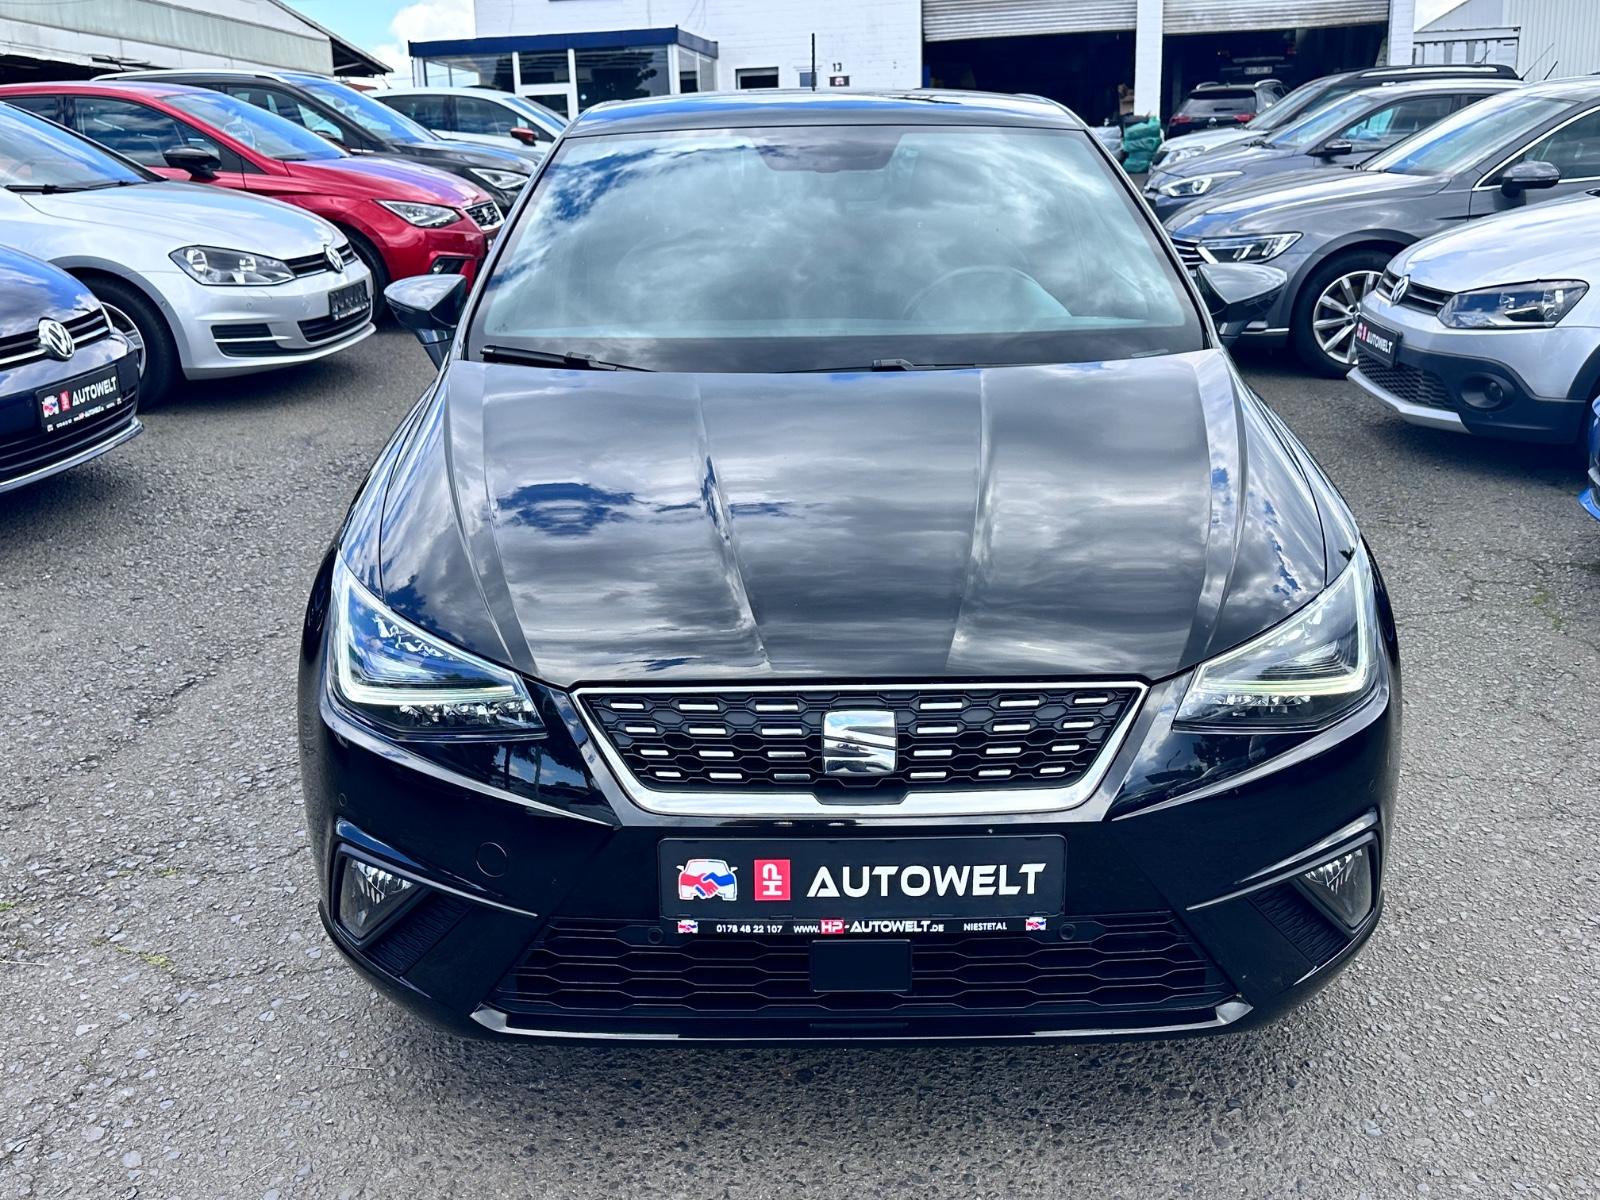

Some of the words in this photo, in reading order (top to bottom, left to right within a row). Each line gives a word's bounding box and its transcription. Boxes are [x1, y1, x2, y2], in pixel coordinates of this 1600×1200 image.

[832, 62, 842, 72] 13
[1366, 331, 1393, 354] AUTOWELT
[72, 376, 116, 406] AUTOWELT
[762, 863, 783, 896] HP
[806, 863, 1047, 898] AUTOWELT
[716, 924, 738, 933] 0178
[739, 924, 751, 933] 48
[752, 924, 764, 933] 22
[766, 924, 783, 933] 107
[963, 922, 1008, 931] NIESTETAL
